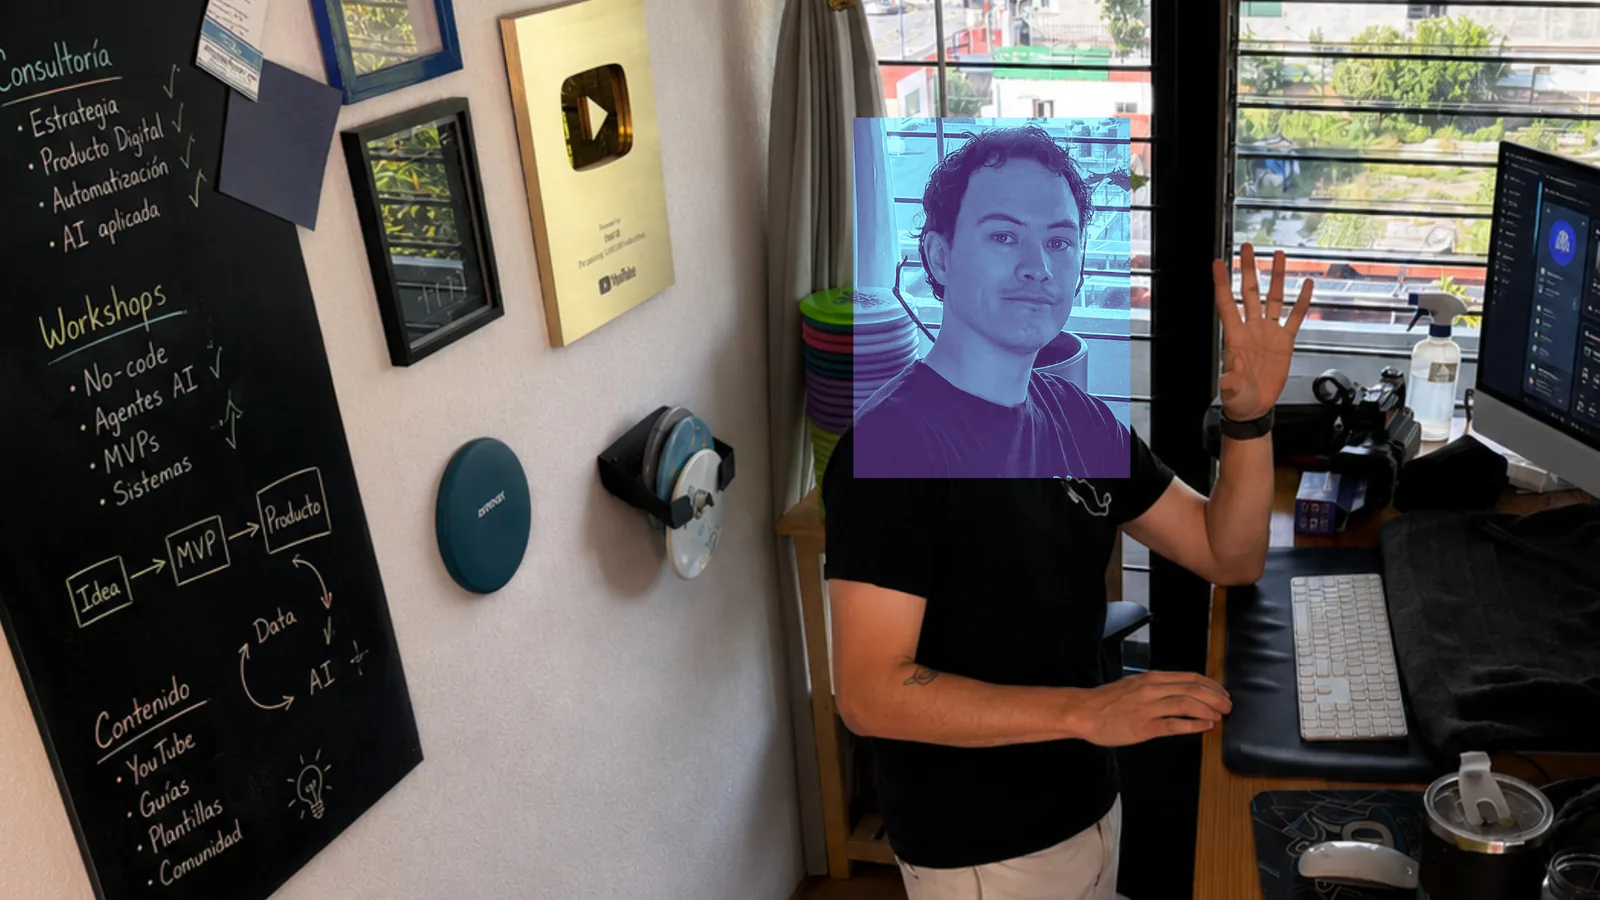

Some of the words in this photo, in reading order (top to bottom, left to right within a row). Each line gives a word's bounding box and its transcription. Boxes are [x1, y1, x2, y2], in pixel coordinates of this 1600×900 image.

[0, 38, 113, 92] Consultoría
[29, 98, 120, 138] Estrategia
[40, 137, 109, 176] Producto
[114, 112, 165, 157] Digital
[53, 156, 169, 213] Automatización
[63, 220, 90, 253] AI
[98, 199, 161, 245] aplicada
[39, 284, 166, 350] Workshops
[84, 342, 168, 396] No-code
[96, 389, 163, 437] Agentes
[173, 365, 198, 398] AI
[104, 430, 160, 474] MVPs
[113, 456, 192, 506] Sistemas
[265, 495, 321, 534] Producto
[176, 529, 216, 568] MVP
[77, 580, 121, 612] Idea
[253, 608, 297, 643] Data
[309, 661, 335, 694] AI
[95, 675, 190, 748] Contenido
[126, 732, 195, 785] YouTube
[140, 780, 190, 817] Guías
[149, 799, 223, 854] Plantillas
[160, 819, 243, 886] Comunidad
